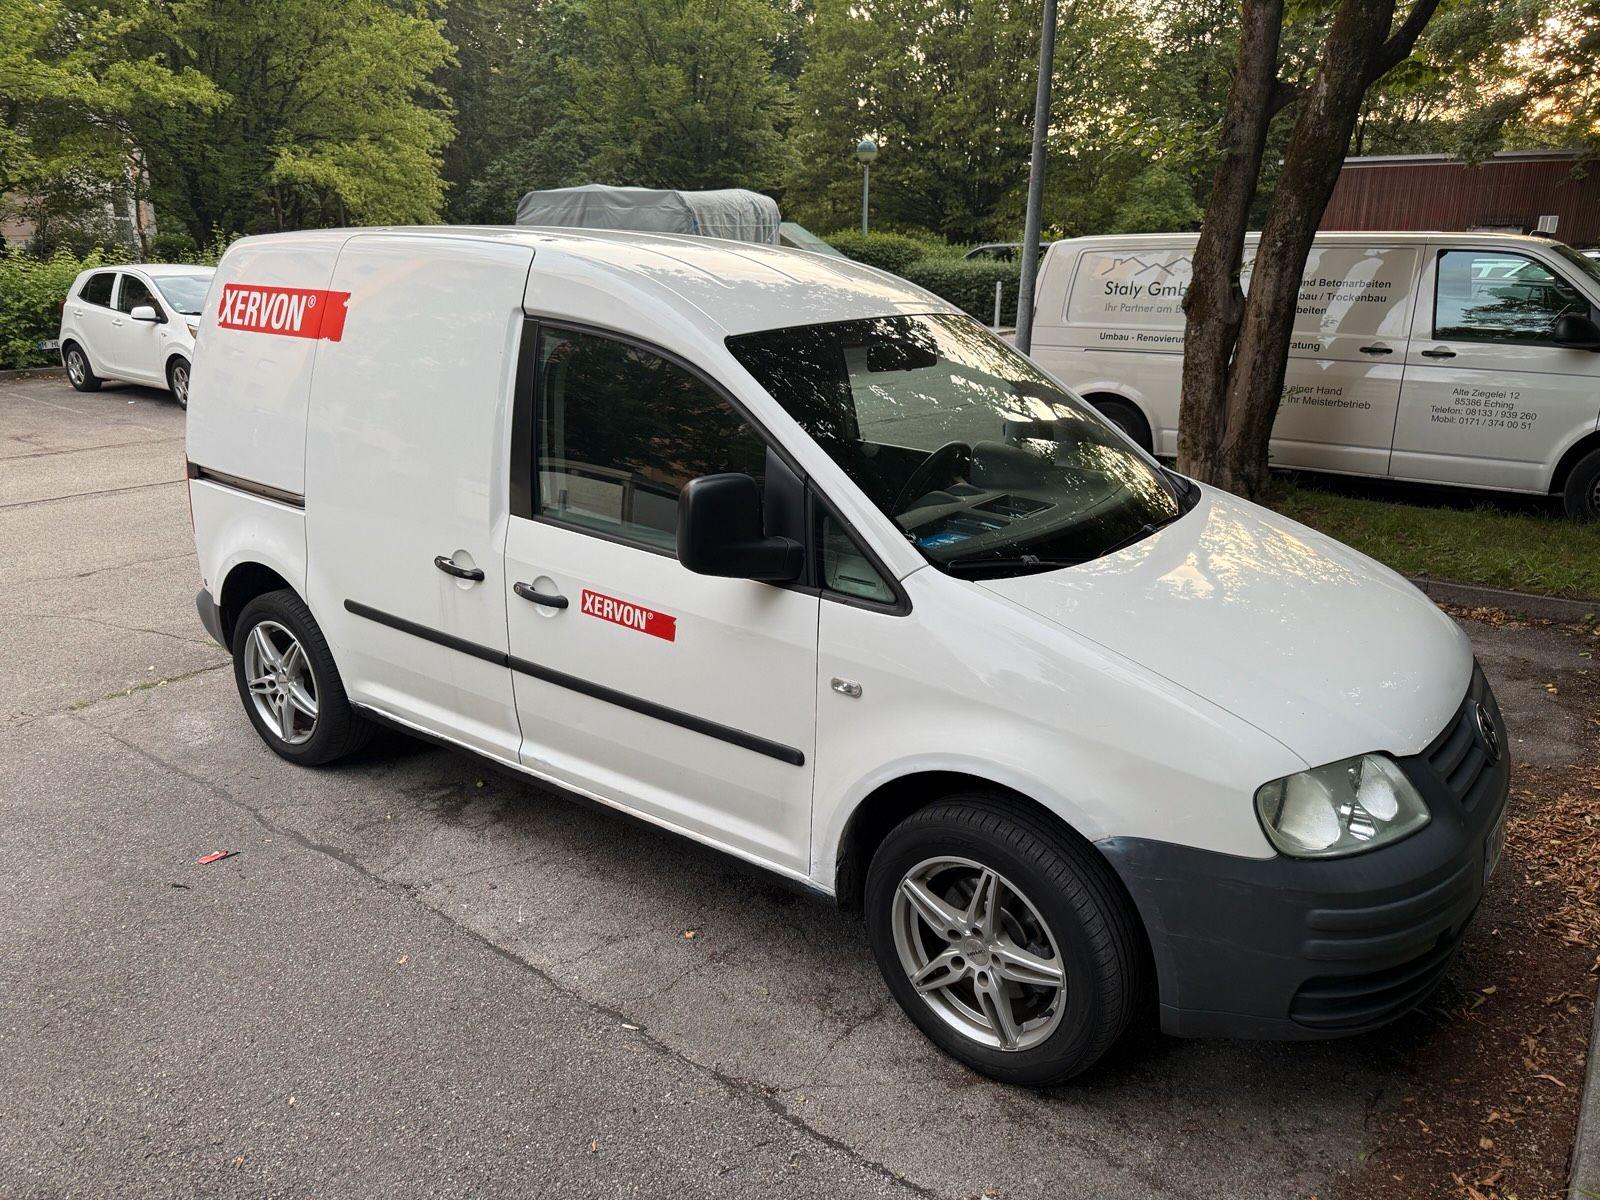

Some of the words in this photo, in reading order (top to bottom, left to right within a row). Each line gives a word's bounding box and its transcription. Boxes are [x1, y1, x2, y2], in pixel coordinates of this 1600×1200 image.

[1318, 278, 1392, 289] Betonarbeiten
[1104, 280, 1143, 300] Staly
[1147, 281, 1188, 297] Gmb
[1298, 293, 1318, 301] bau
[1326, 292, 1387, 303] Trockenbau
[1104, 302, 1118, 312] Ihr
[1119, 302, 1155, 313] Partner
[1156, 305, 1172, 314] am
[1296, 305, 1327, 315] beiten
[1099, 332, 1129, 341] Umbau
[1290, 340, 1321, 352] atung
[1316, 386, 1343, 397] Hand
[1452, 387, 1470, 397] Alte
[1471, 388, 1507, 400] Ziegelei
[1509, 391, 1521, 400] 12
[1302, 396, 1371, 410] Meisterbetrieb
[1454, 397, 1482, 407] 85386
[1483, 399, 1515, 411] Eching
[1431, 405, 1464, 415] Telefon:
[1465, 407, 1493, 418] 08133
[1500, 410, 1518, 419] 939
[1519, 411, 1537, 421] 260
[1431, 414, 1457, 424] Mobil:
[1458, 416, 1480, 426] 0171
[1487, 419, 1504, 428] 374
[1506, 420, 1519, 430] 00
[1520, 421, 1532, 430] 51
